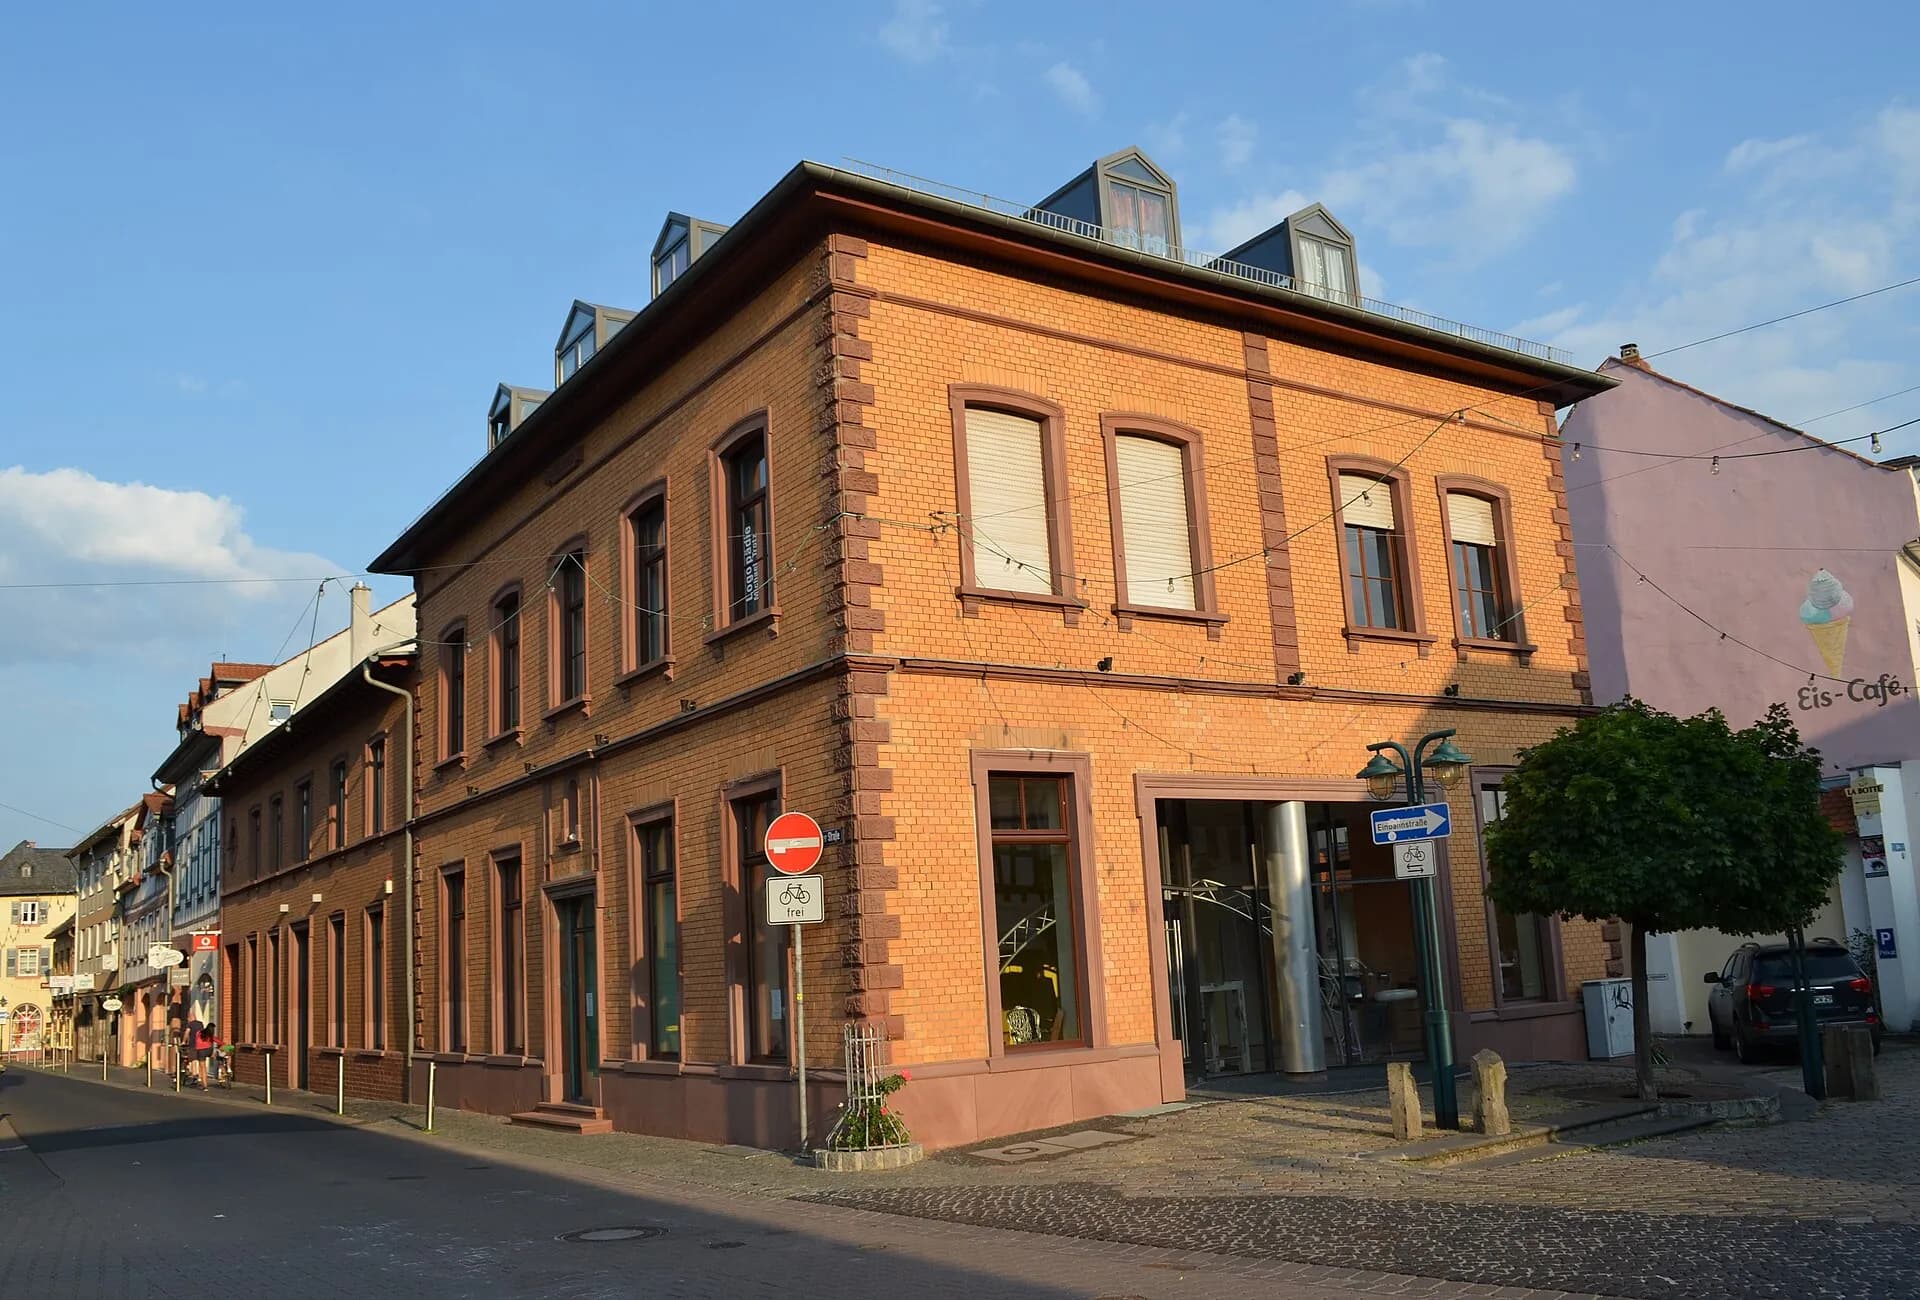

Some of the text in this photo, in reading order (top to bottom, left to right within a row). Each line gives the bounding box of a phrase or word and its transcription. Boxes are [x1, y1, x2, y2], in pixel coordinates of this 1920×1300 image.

[1797, 673, 1901, 711] Eis-Café
[1847, 788, 1857, 796] LA
[1858, 784, 1884, 794] BOTTE
[787, 907, 804, 917] frei
